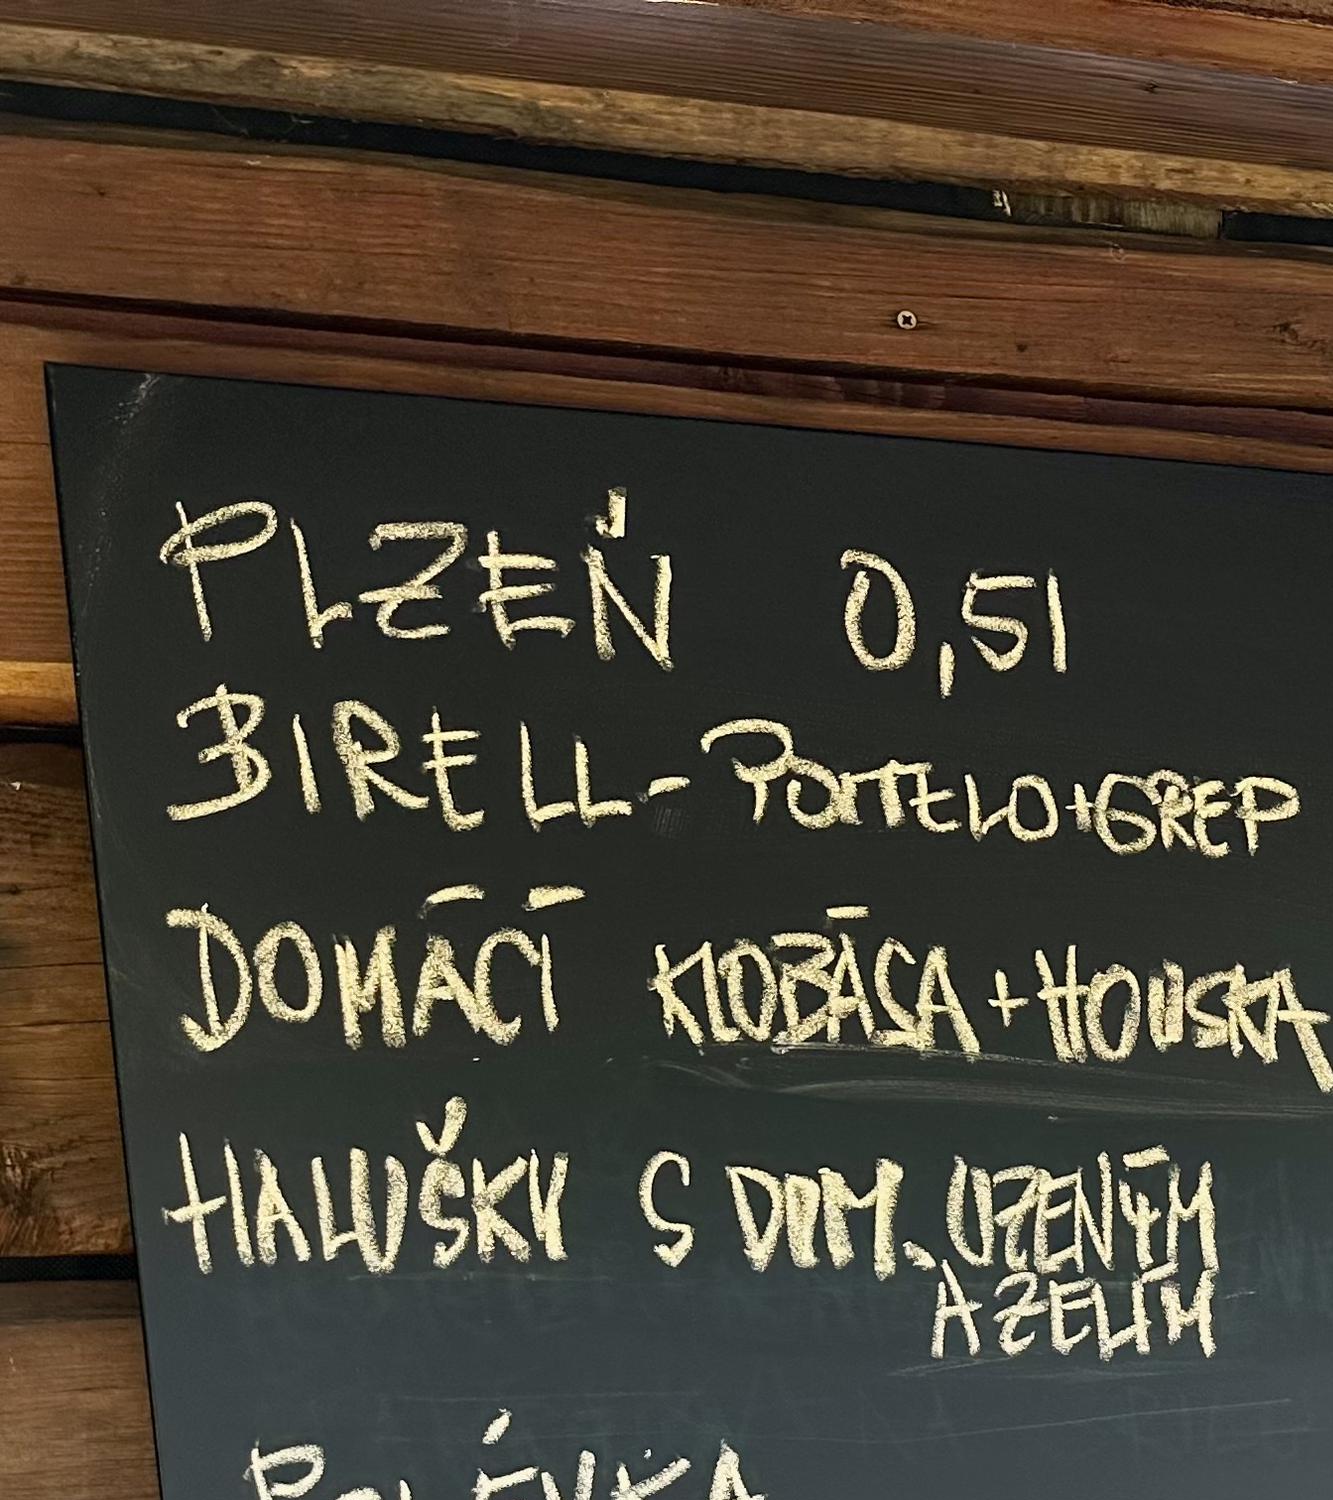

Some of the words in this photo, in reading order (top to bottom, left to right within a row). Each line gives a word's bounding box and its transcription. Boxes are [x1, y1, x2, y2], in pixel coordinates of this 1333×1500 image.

[158, 488, 674, 669] PLZEŇ
[165, 883, 586, 1053] DOMÁCÍ
[160, 1095, 570, 1276] HALUŠKY
[637, 1149, 695, 1269] S
[723, 1157, 936, 1281] DOM.
[945, 1146, 1221, 1277] UZENÝM
